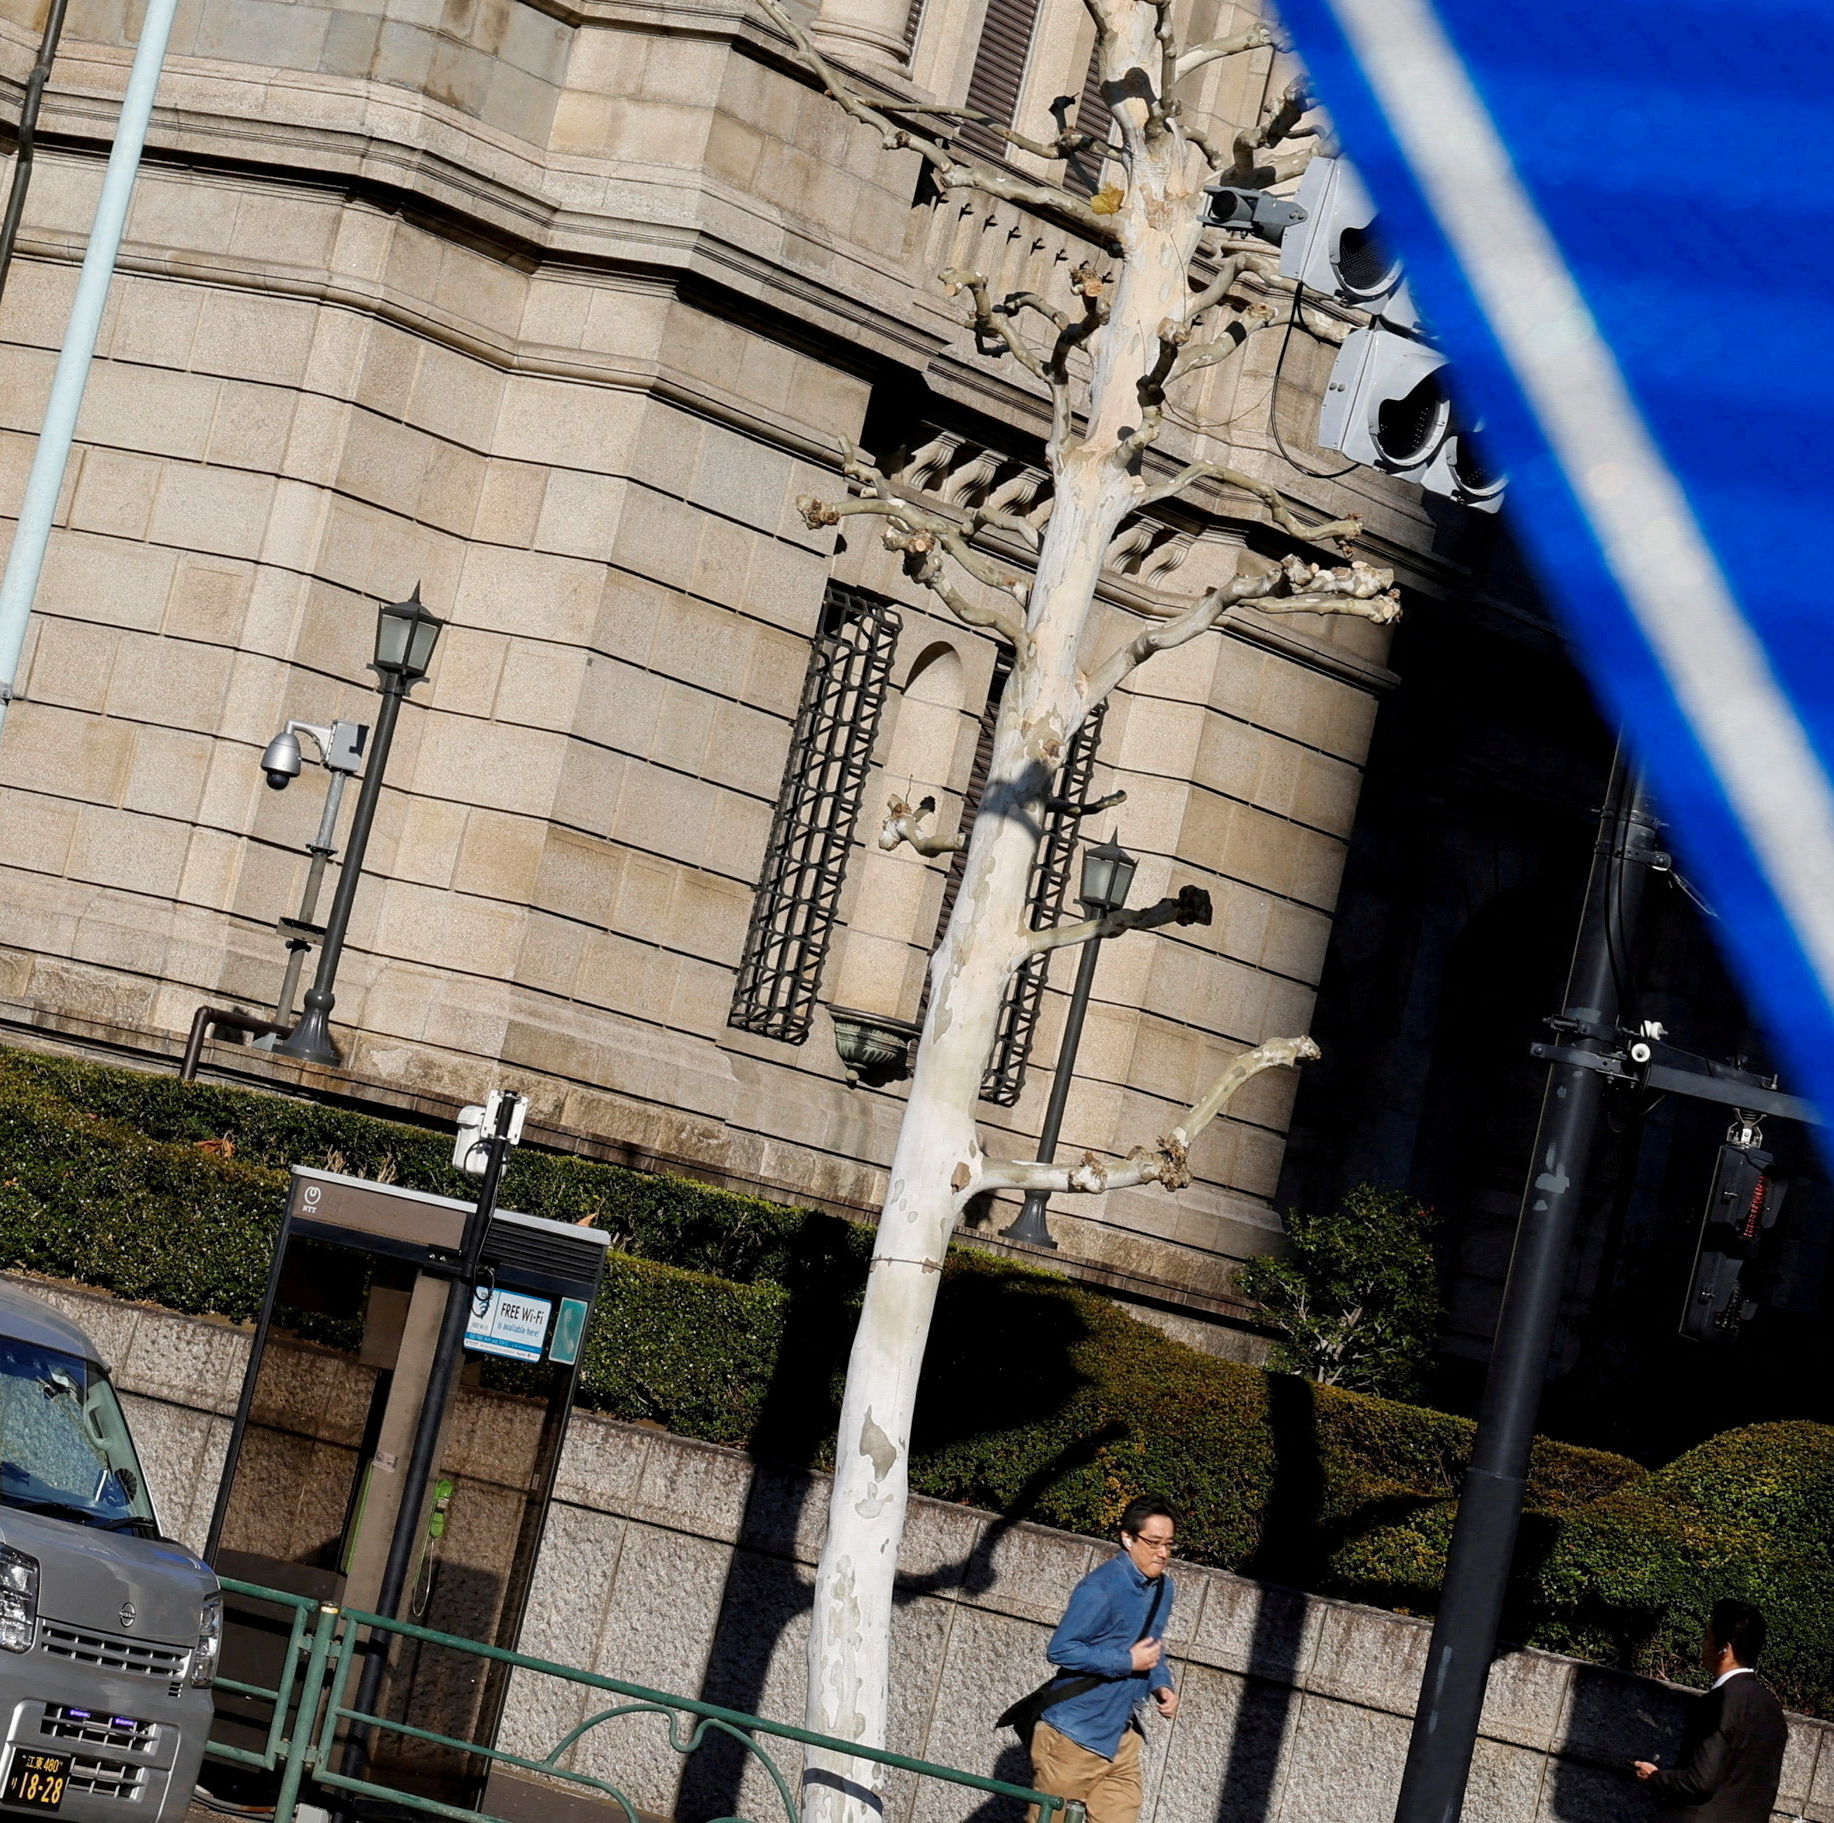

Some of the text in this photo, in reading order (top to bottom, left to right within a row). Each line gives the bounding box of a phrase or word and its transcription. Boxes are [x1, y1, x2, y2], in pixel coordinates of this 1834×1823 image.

[302, 1204, 317, 1213] NTT
[501, 1302, 544, 1325] FREE Wi-Fi
[503, 1322, 526, 1336] available
[19, 1772, 63, 1804] 18-28
